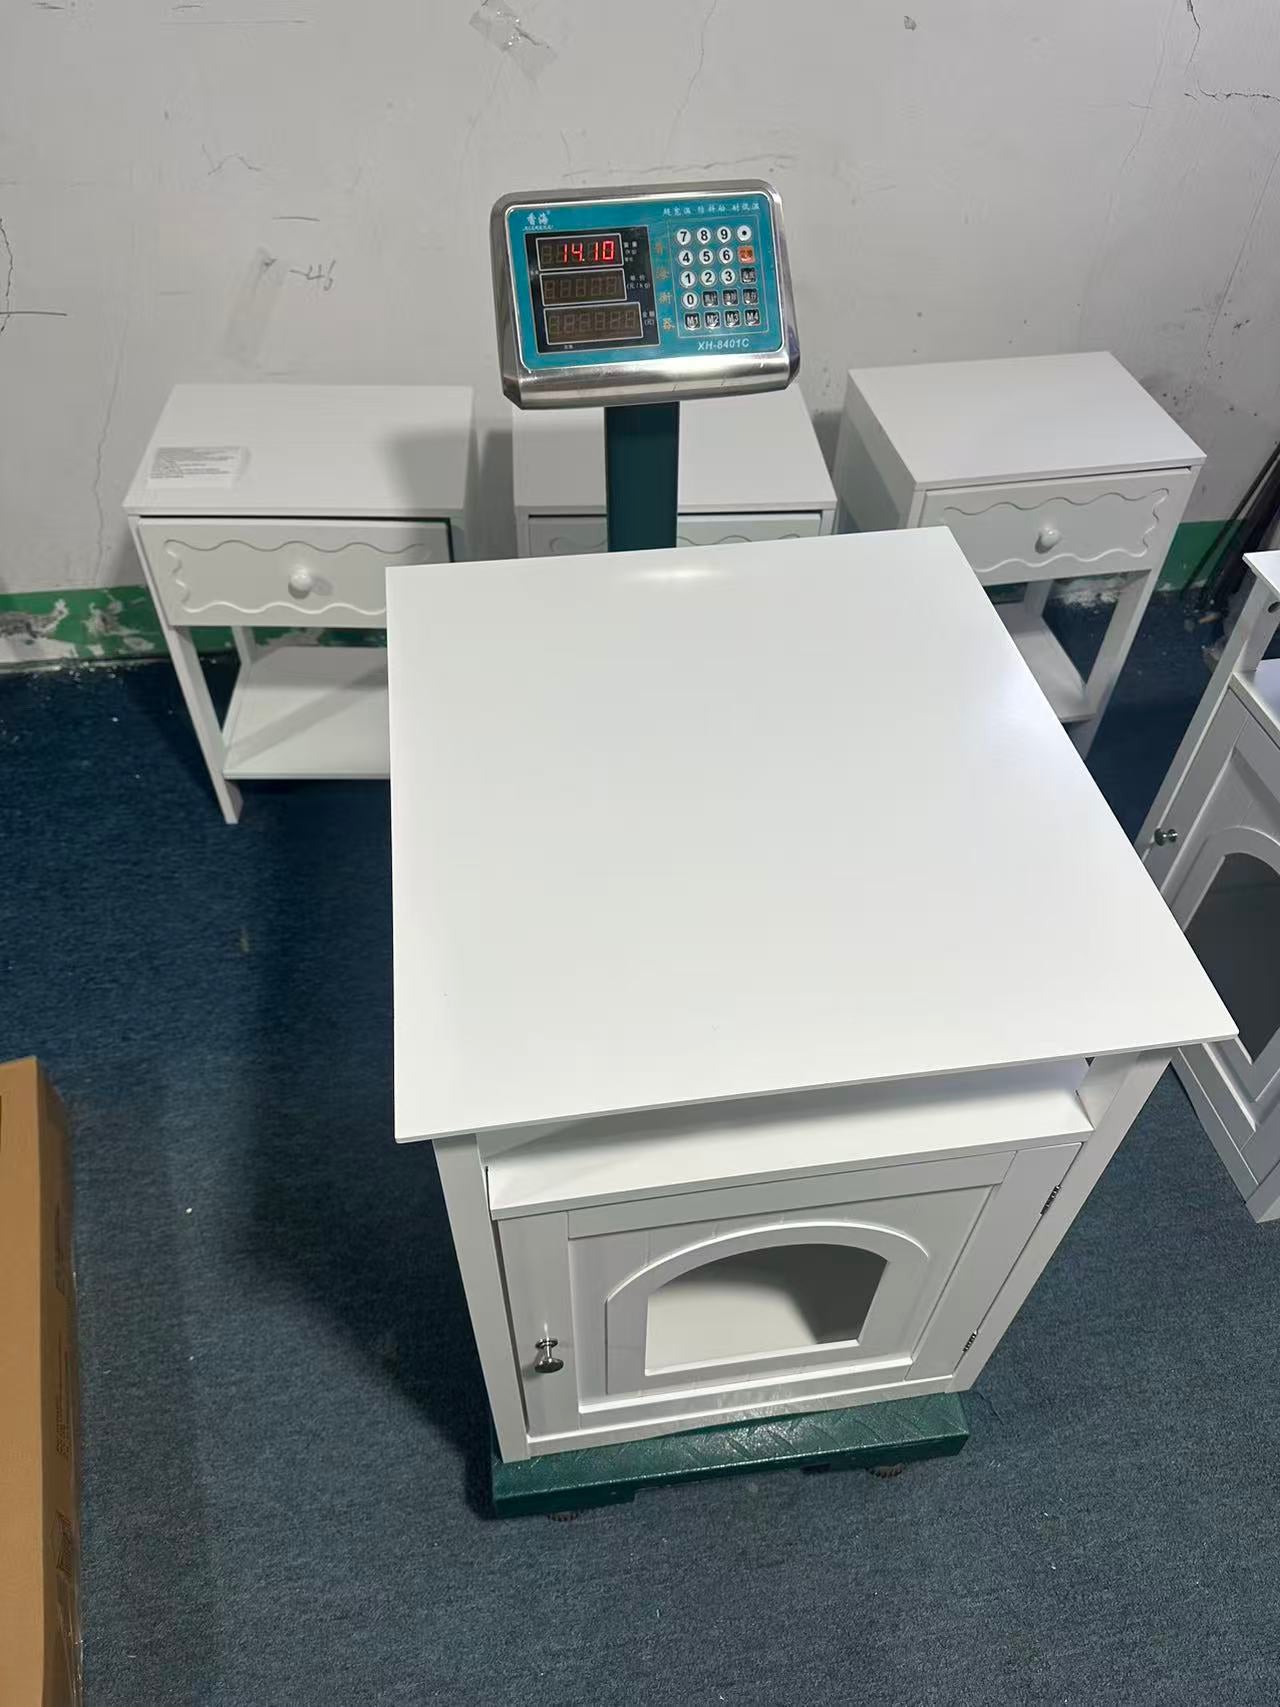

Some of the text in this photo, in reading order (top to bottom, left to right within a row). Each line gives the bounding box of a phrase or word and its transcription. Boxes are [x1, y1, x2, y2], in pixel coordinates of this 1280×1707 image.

[680, 229, 728, 242] 7 8 9
[563, 240, 615, 263] 14.10
[682, 252, 690, 263] 4
[703, 251, 711, 262] 5
[722, 250, 730, 261] 6
[685, 273, 691, 284] 1
[704, 272, 712, 283] 2
[724, 271, 732, 282] 3
[686, 294, 694, 305] 0
[687, 312, 759, 326] M1 M2 M3 M4
[698, 338, 750, 352] XH-8401C
